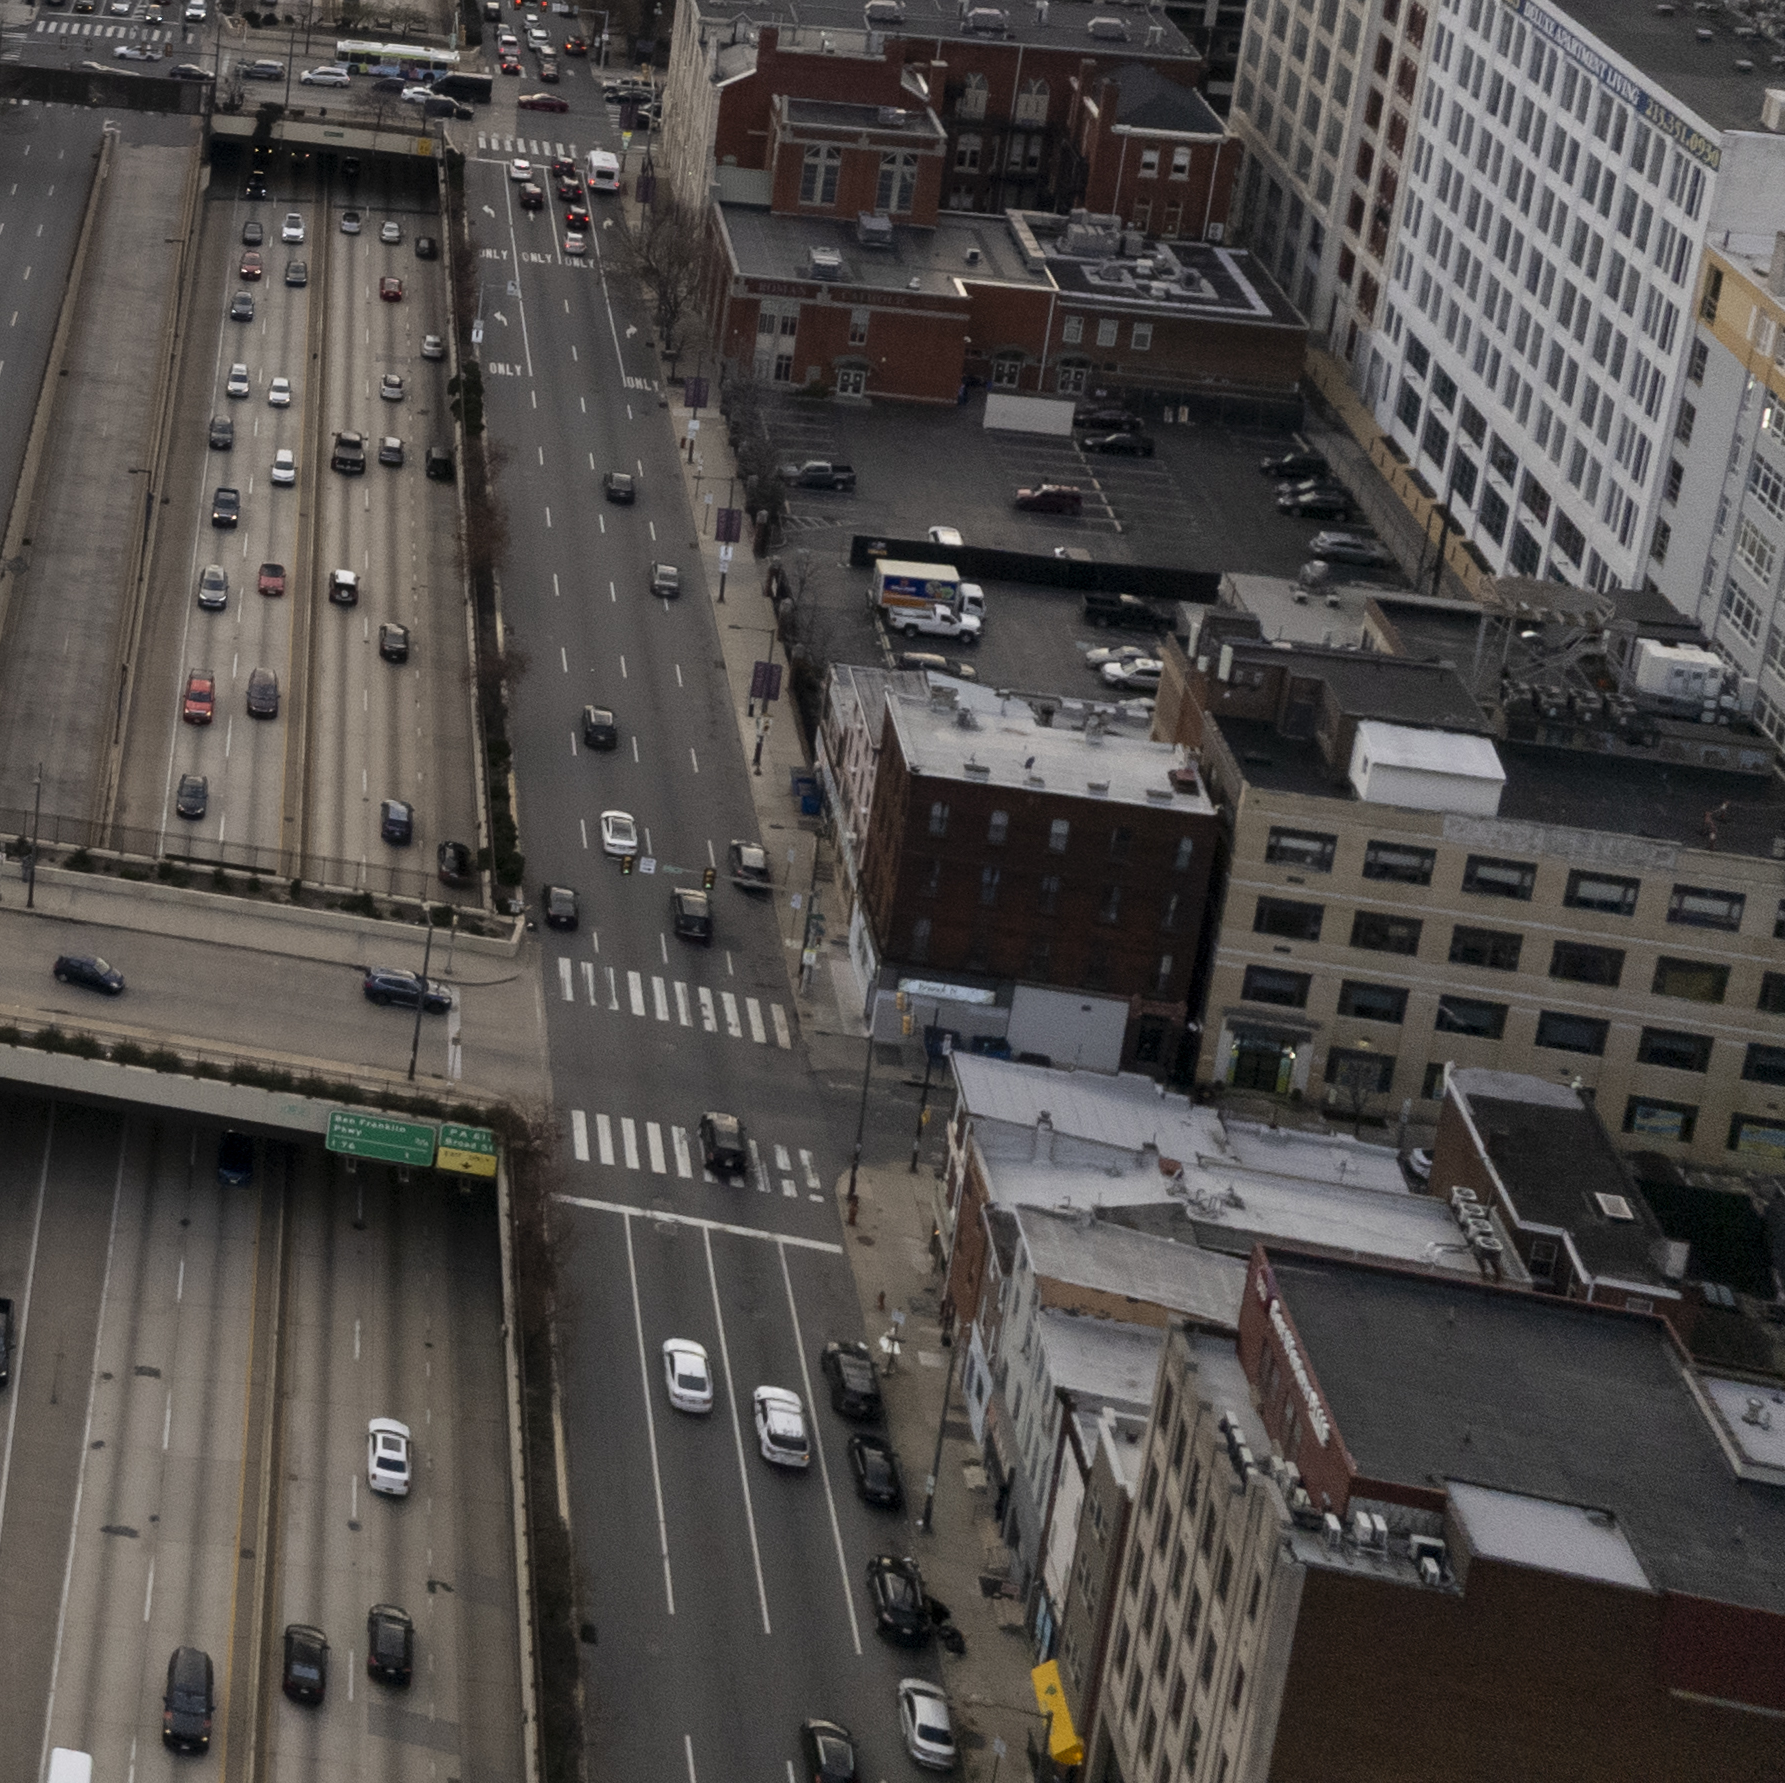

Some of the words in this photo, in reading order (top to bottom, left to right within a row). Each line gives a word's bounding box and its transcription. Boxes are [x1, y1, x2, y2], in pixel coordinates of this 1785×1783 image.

[1555, 25, 1607, 79] APARTMENT
[1607, 66, 1641, 106] LIVING
[521, 251, 553, 264] ONLY
[564, 257, 595, 269] ONLY
[757, 282, 808, 297] ROMAN
[489, 361, 522, 376] ONLY
[626, 376, 660, 392] ONLY
[333, 1124, 363, 1137] Pkwy
[334, 1114, 356, 1125] Ben
[359, 1118, 407, 1133] Franklin
[450, 1128, 468, 1138] PA
[444, 1137, 477, 1150] Broad
